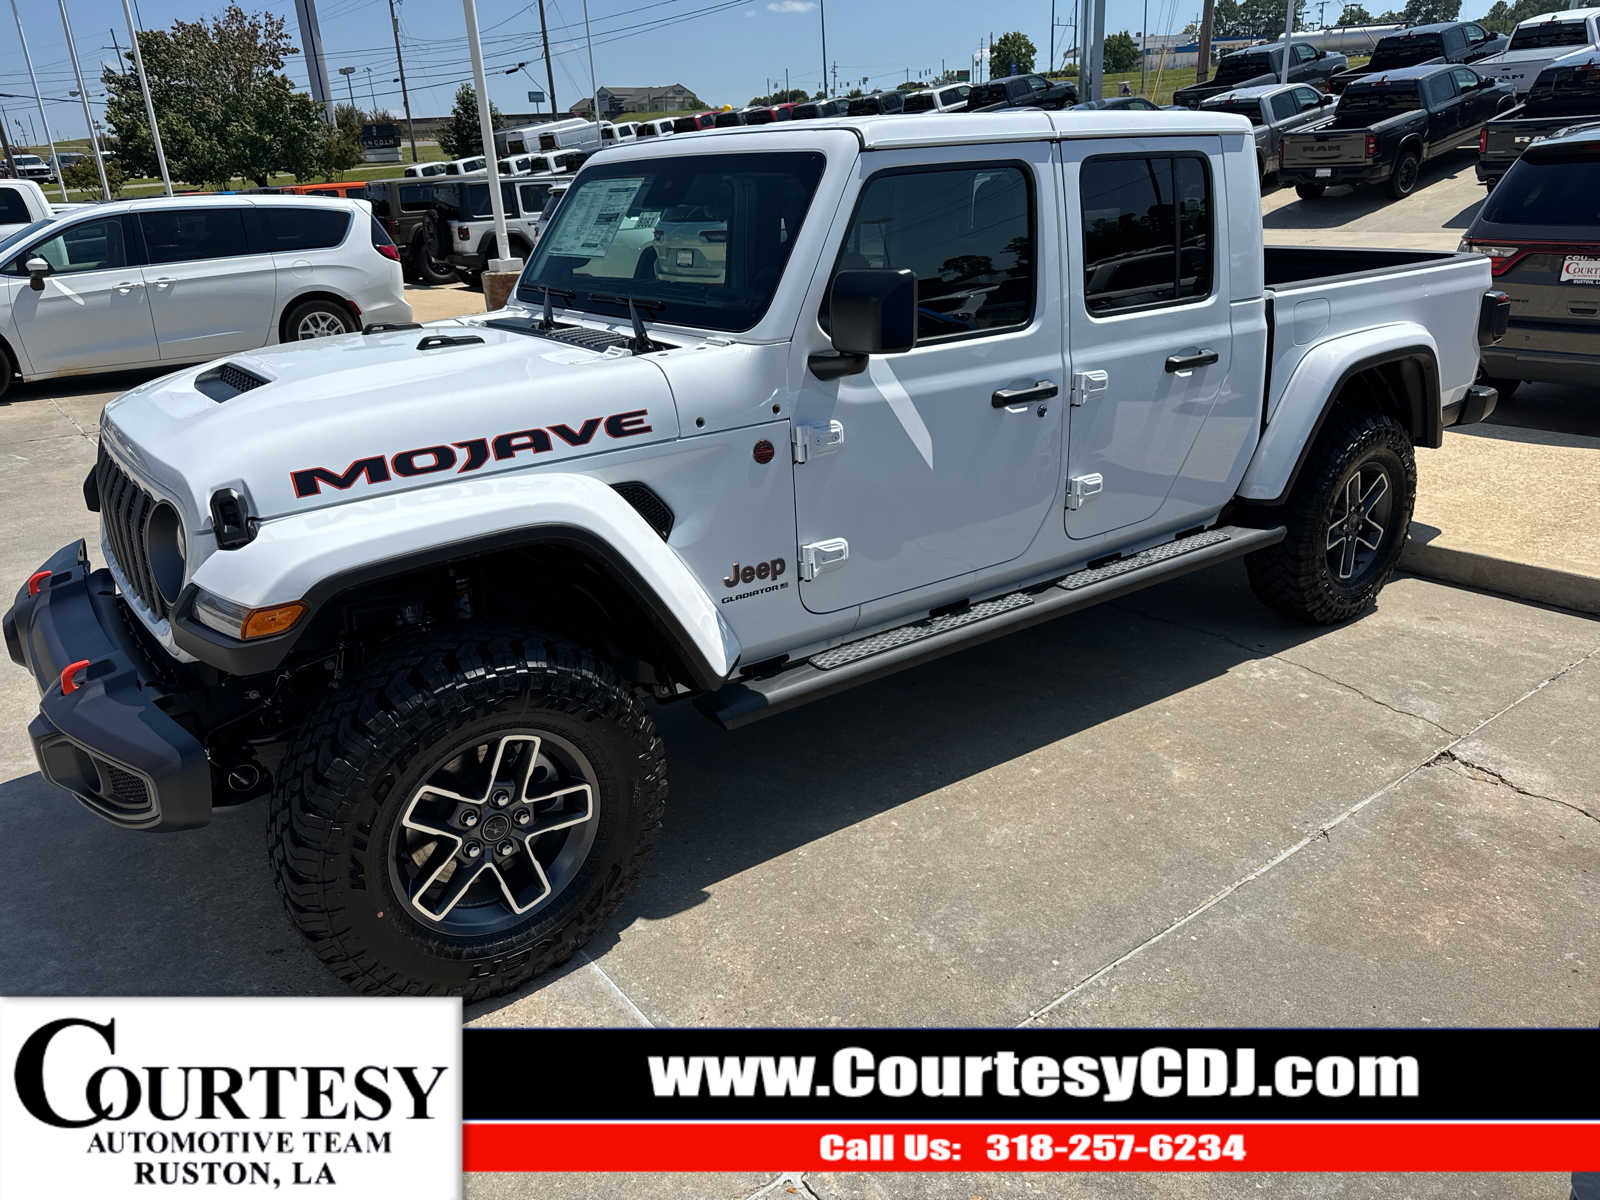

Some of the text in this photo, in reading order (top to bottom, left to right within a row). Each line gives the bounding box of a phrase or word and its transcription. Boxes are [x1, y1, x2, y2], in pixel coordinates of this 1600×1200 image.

[1302, 145, 1341, 153] RAM
[290, 409, 652, 499] MOJAVE
[722, 557, 786, 588] Jeep
[721, 584, 778, 604] GLADIATOR
